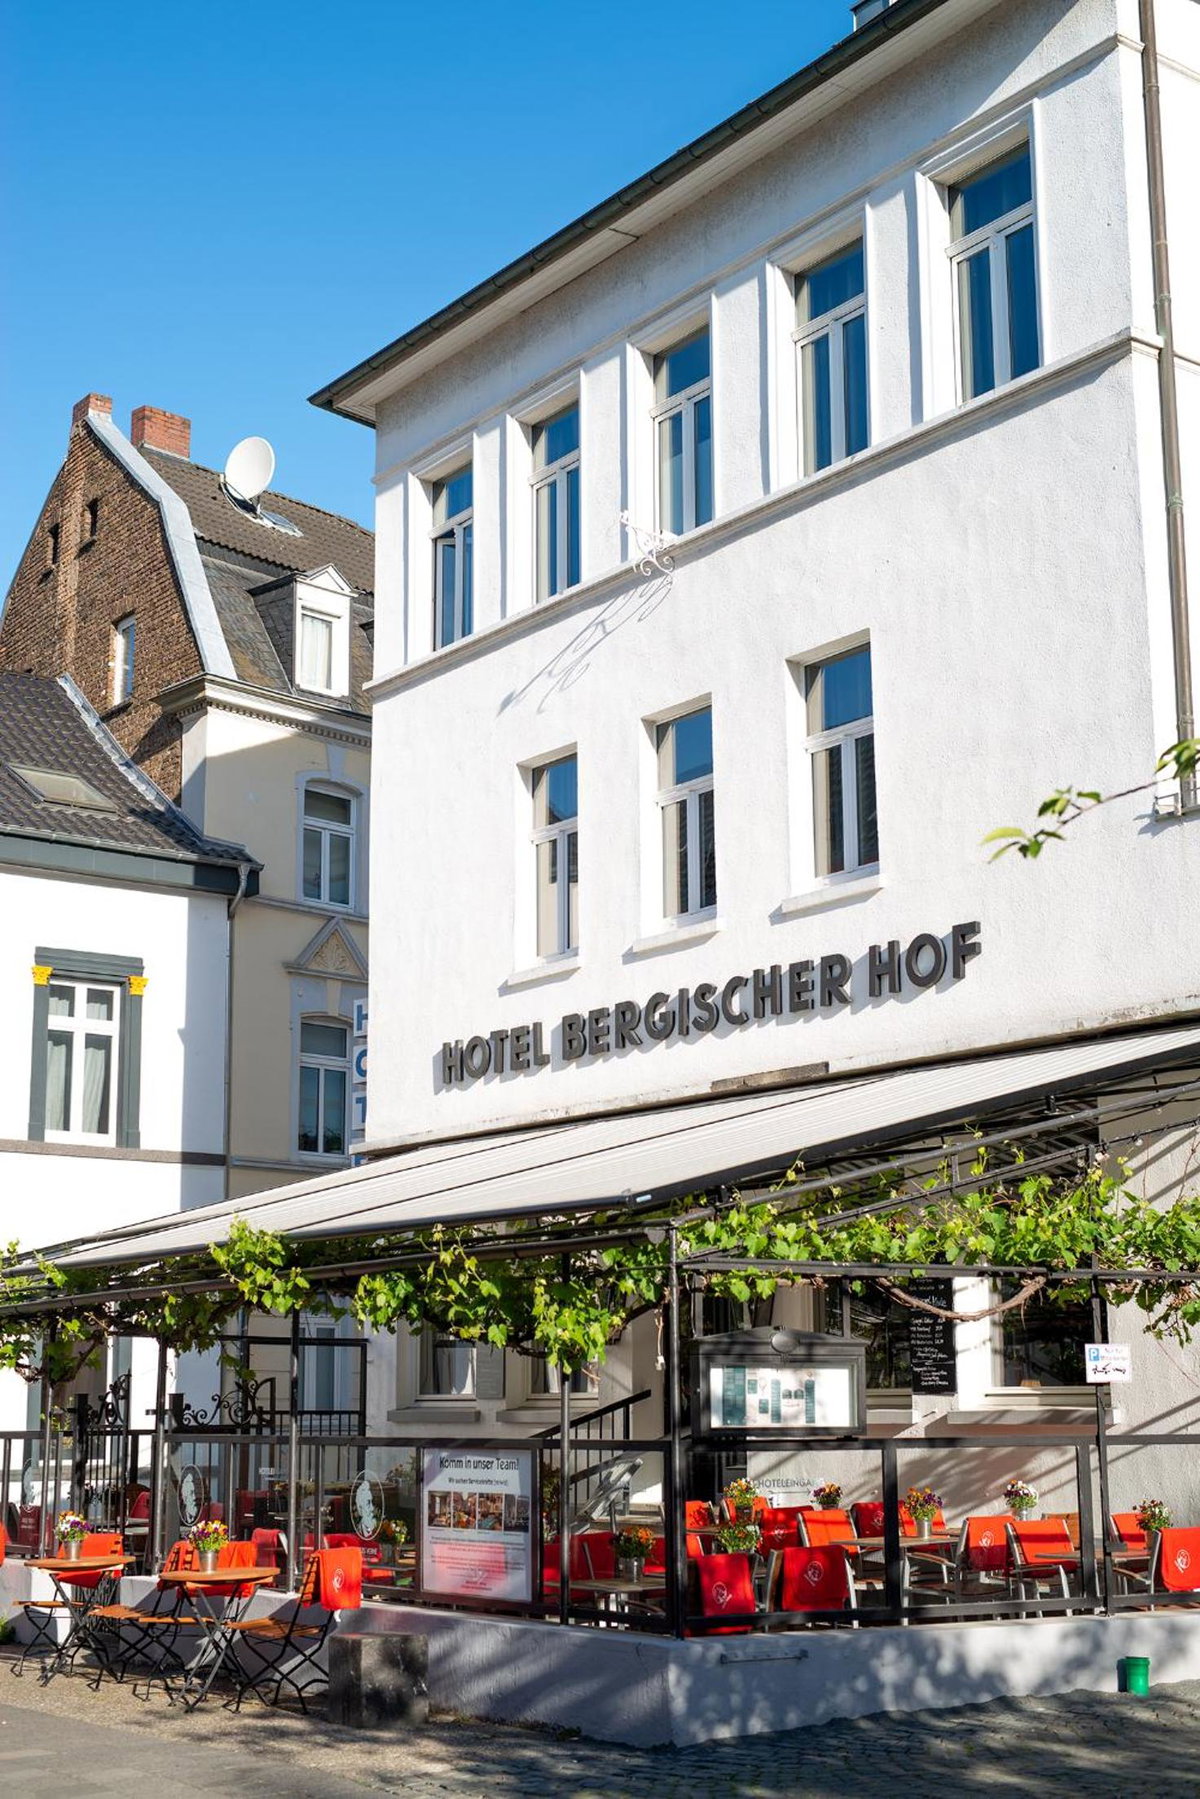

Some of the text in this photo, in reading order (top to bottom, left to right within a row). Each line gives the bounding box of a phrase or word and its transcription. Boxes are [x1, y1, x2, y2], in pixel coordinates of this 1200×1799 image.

[442, 920, 983, 1085] HOTEL BERGISCHER HOF
[440, 1457, 519, 1471] Komm in unser Team!
